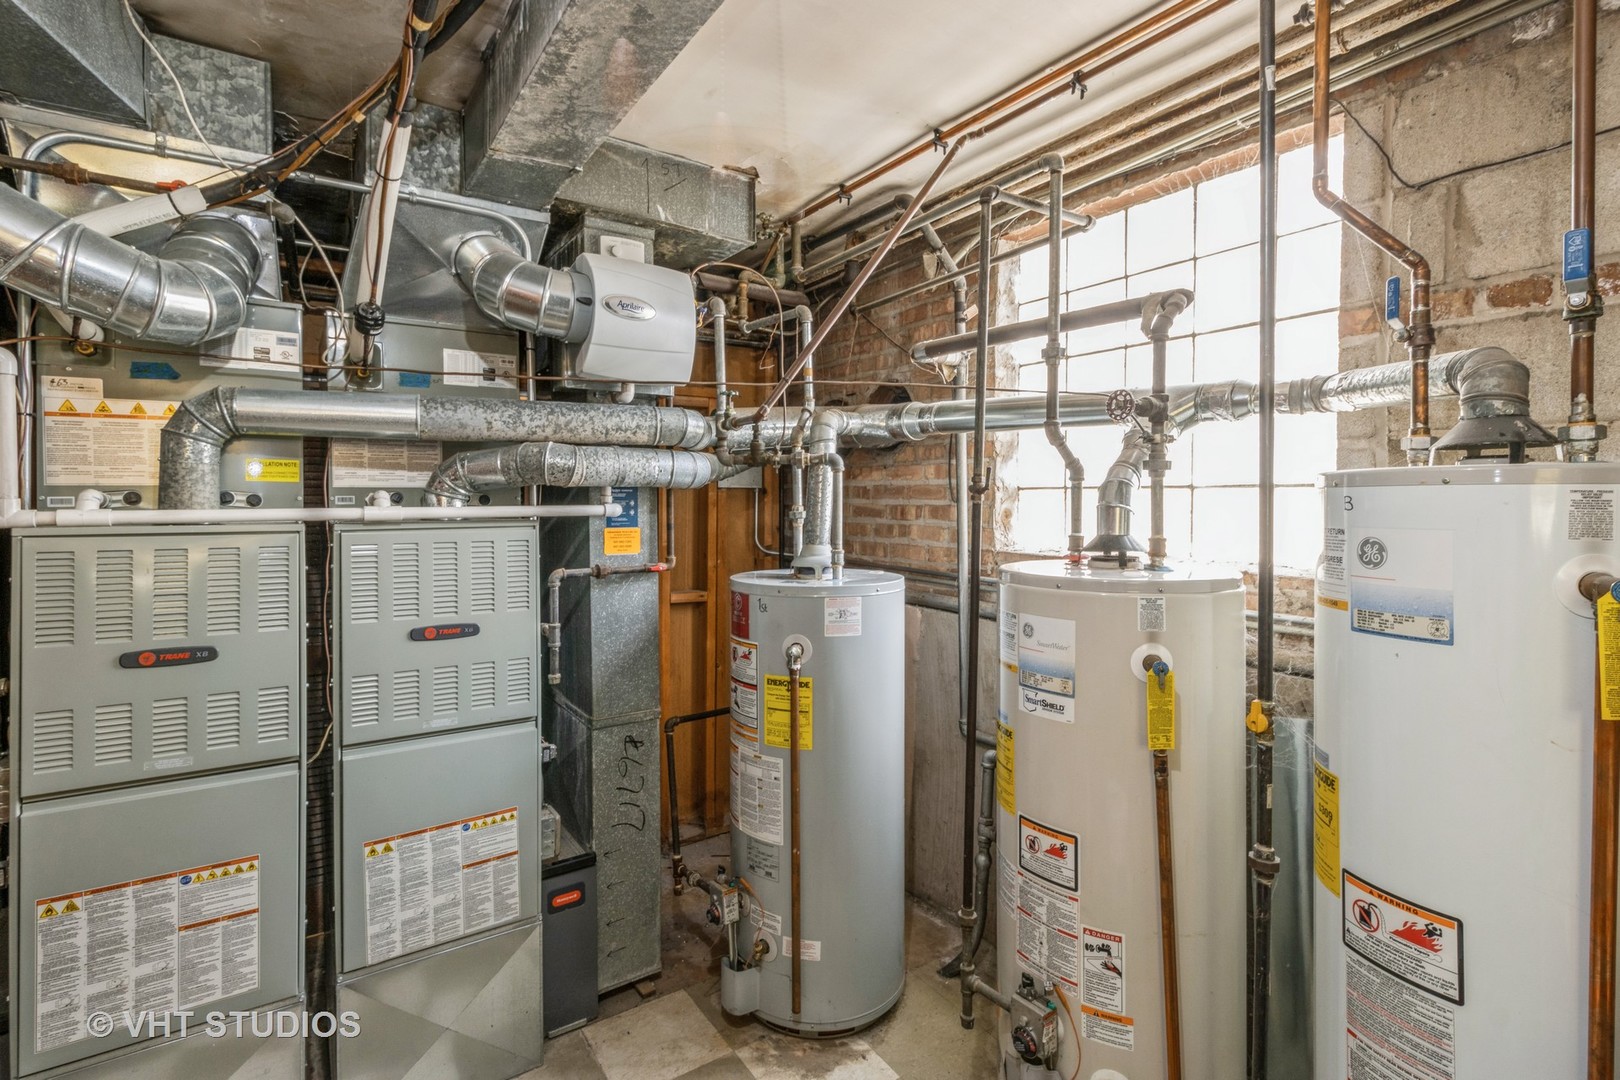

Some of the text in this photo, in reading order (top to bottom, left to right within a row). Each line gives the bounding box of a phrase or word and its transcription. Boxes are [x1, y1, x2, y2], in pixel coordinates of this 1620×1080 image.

[617, 300, 645, 312] Aprilaire
[160, 652, 191, 661] TRANE
[1376, 892, 1418, 915] WARNING
[1091, 930, 1121, 943] DANGER
